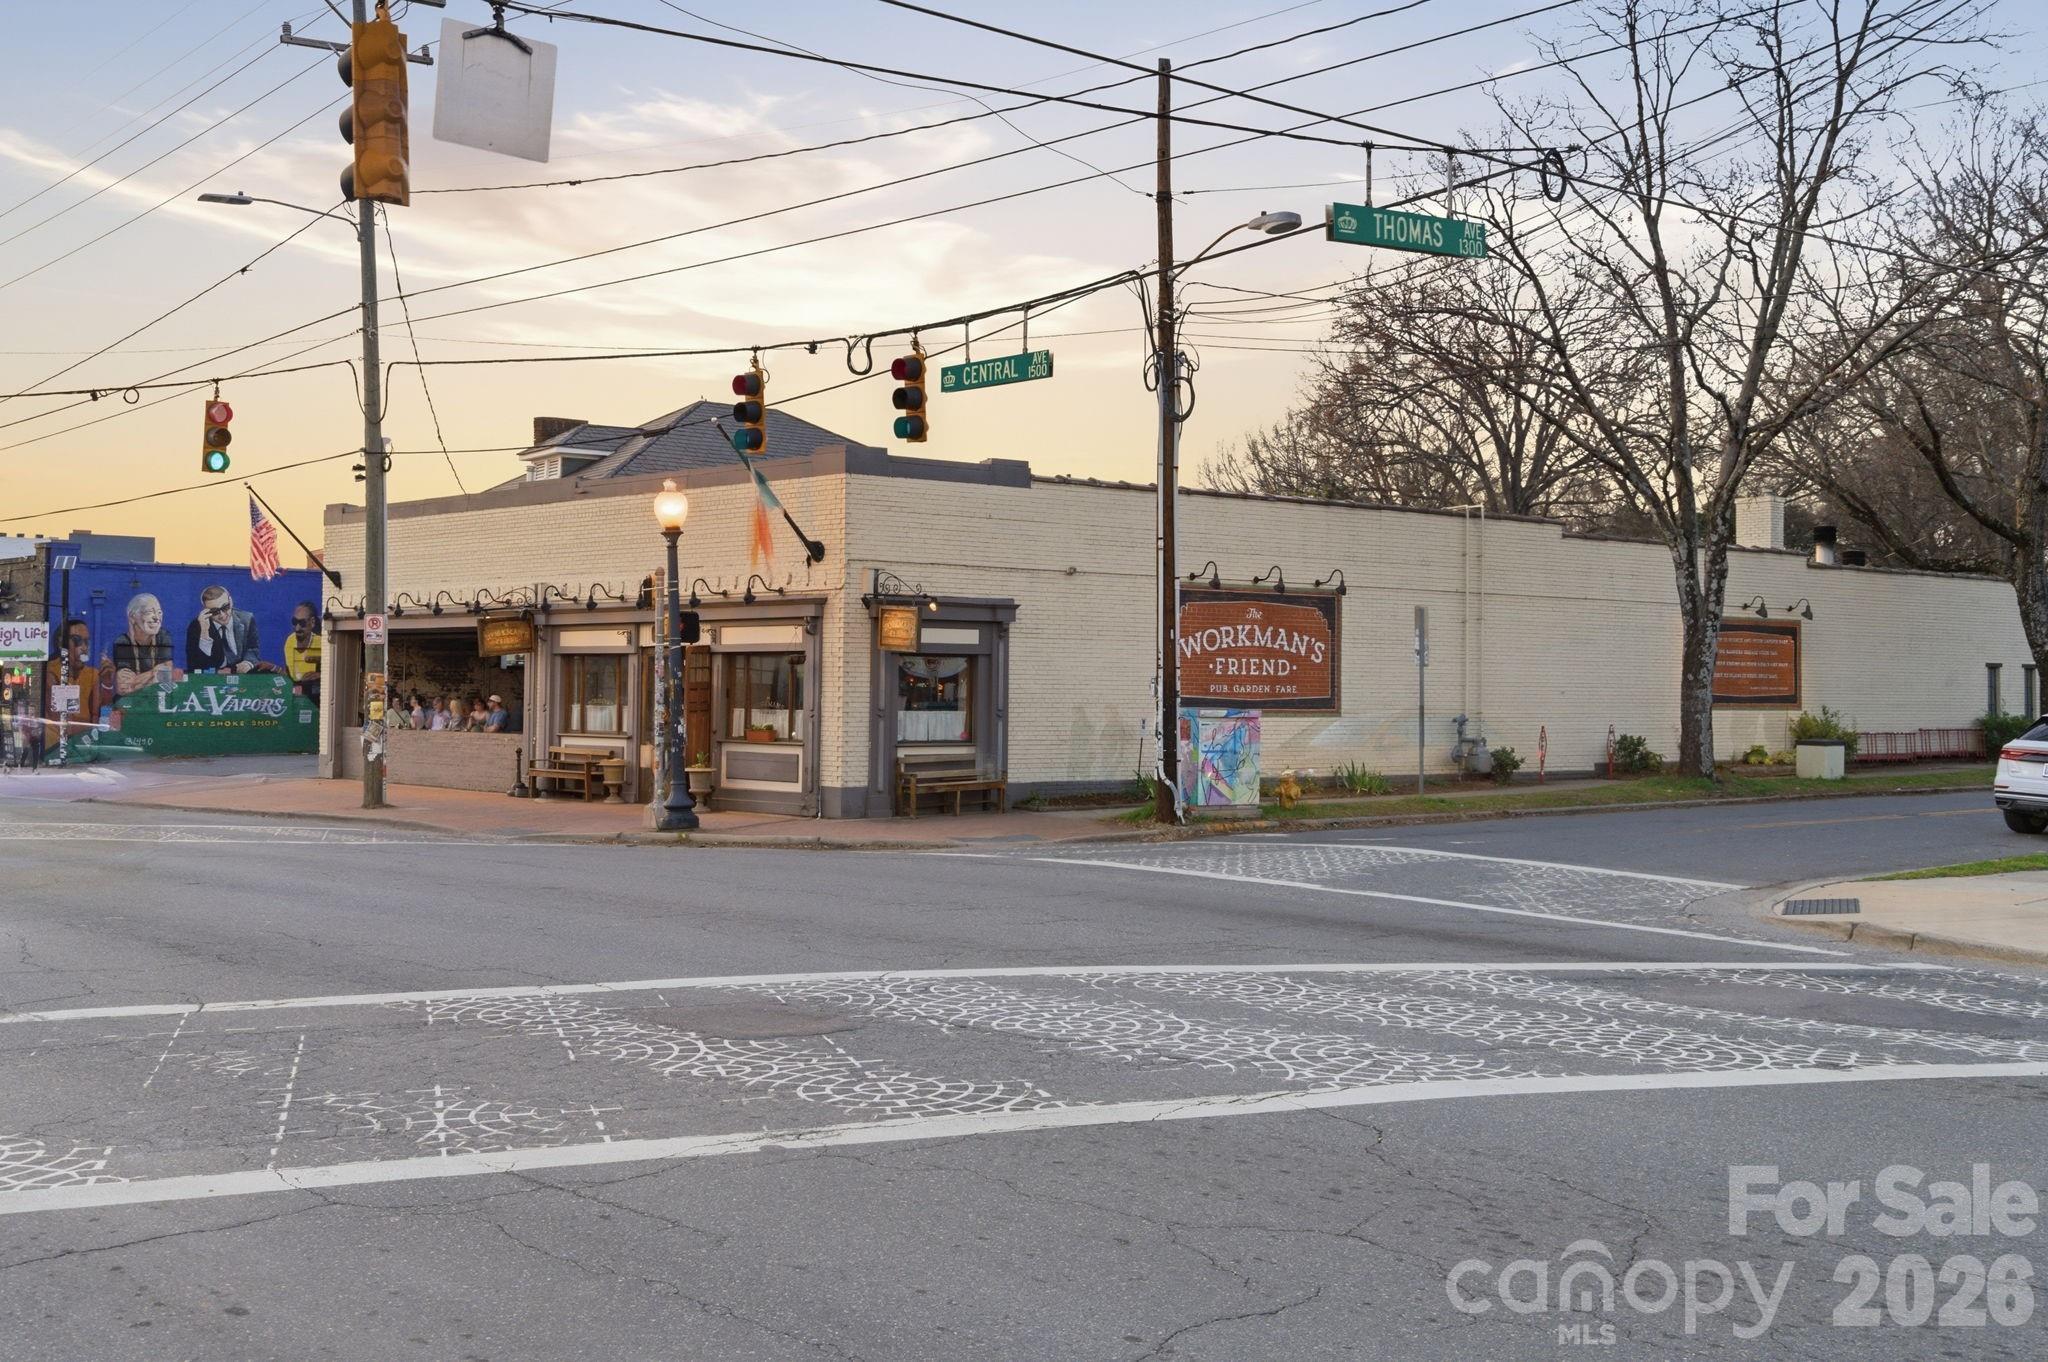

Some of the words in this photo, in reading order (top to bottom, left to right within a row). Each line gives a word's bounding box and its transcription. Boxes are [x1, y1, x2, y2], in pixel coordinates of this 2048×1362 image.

[1373, 213, 1443, 247] THOMAS
[1464, 222, 1481, 240] AVE
[1459, 239, 1482, 257] 1300
[963, 359, 1018, 385] CENTRAL
[1032, 351, 1047, 365] AVE
[1028, 364, 1048, 378] 1500
[1246, 607, 1263, 619] The
[0, 627, 22, 647] igh
[1179, 625, 1326, 663] WORKMAN'S
[1215, 658, 1290, 676] FRIEND
[1275, 686, 1297, 694] FARE
